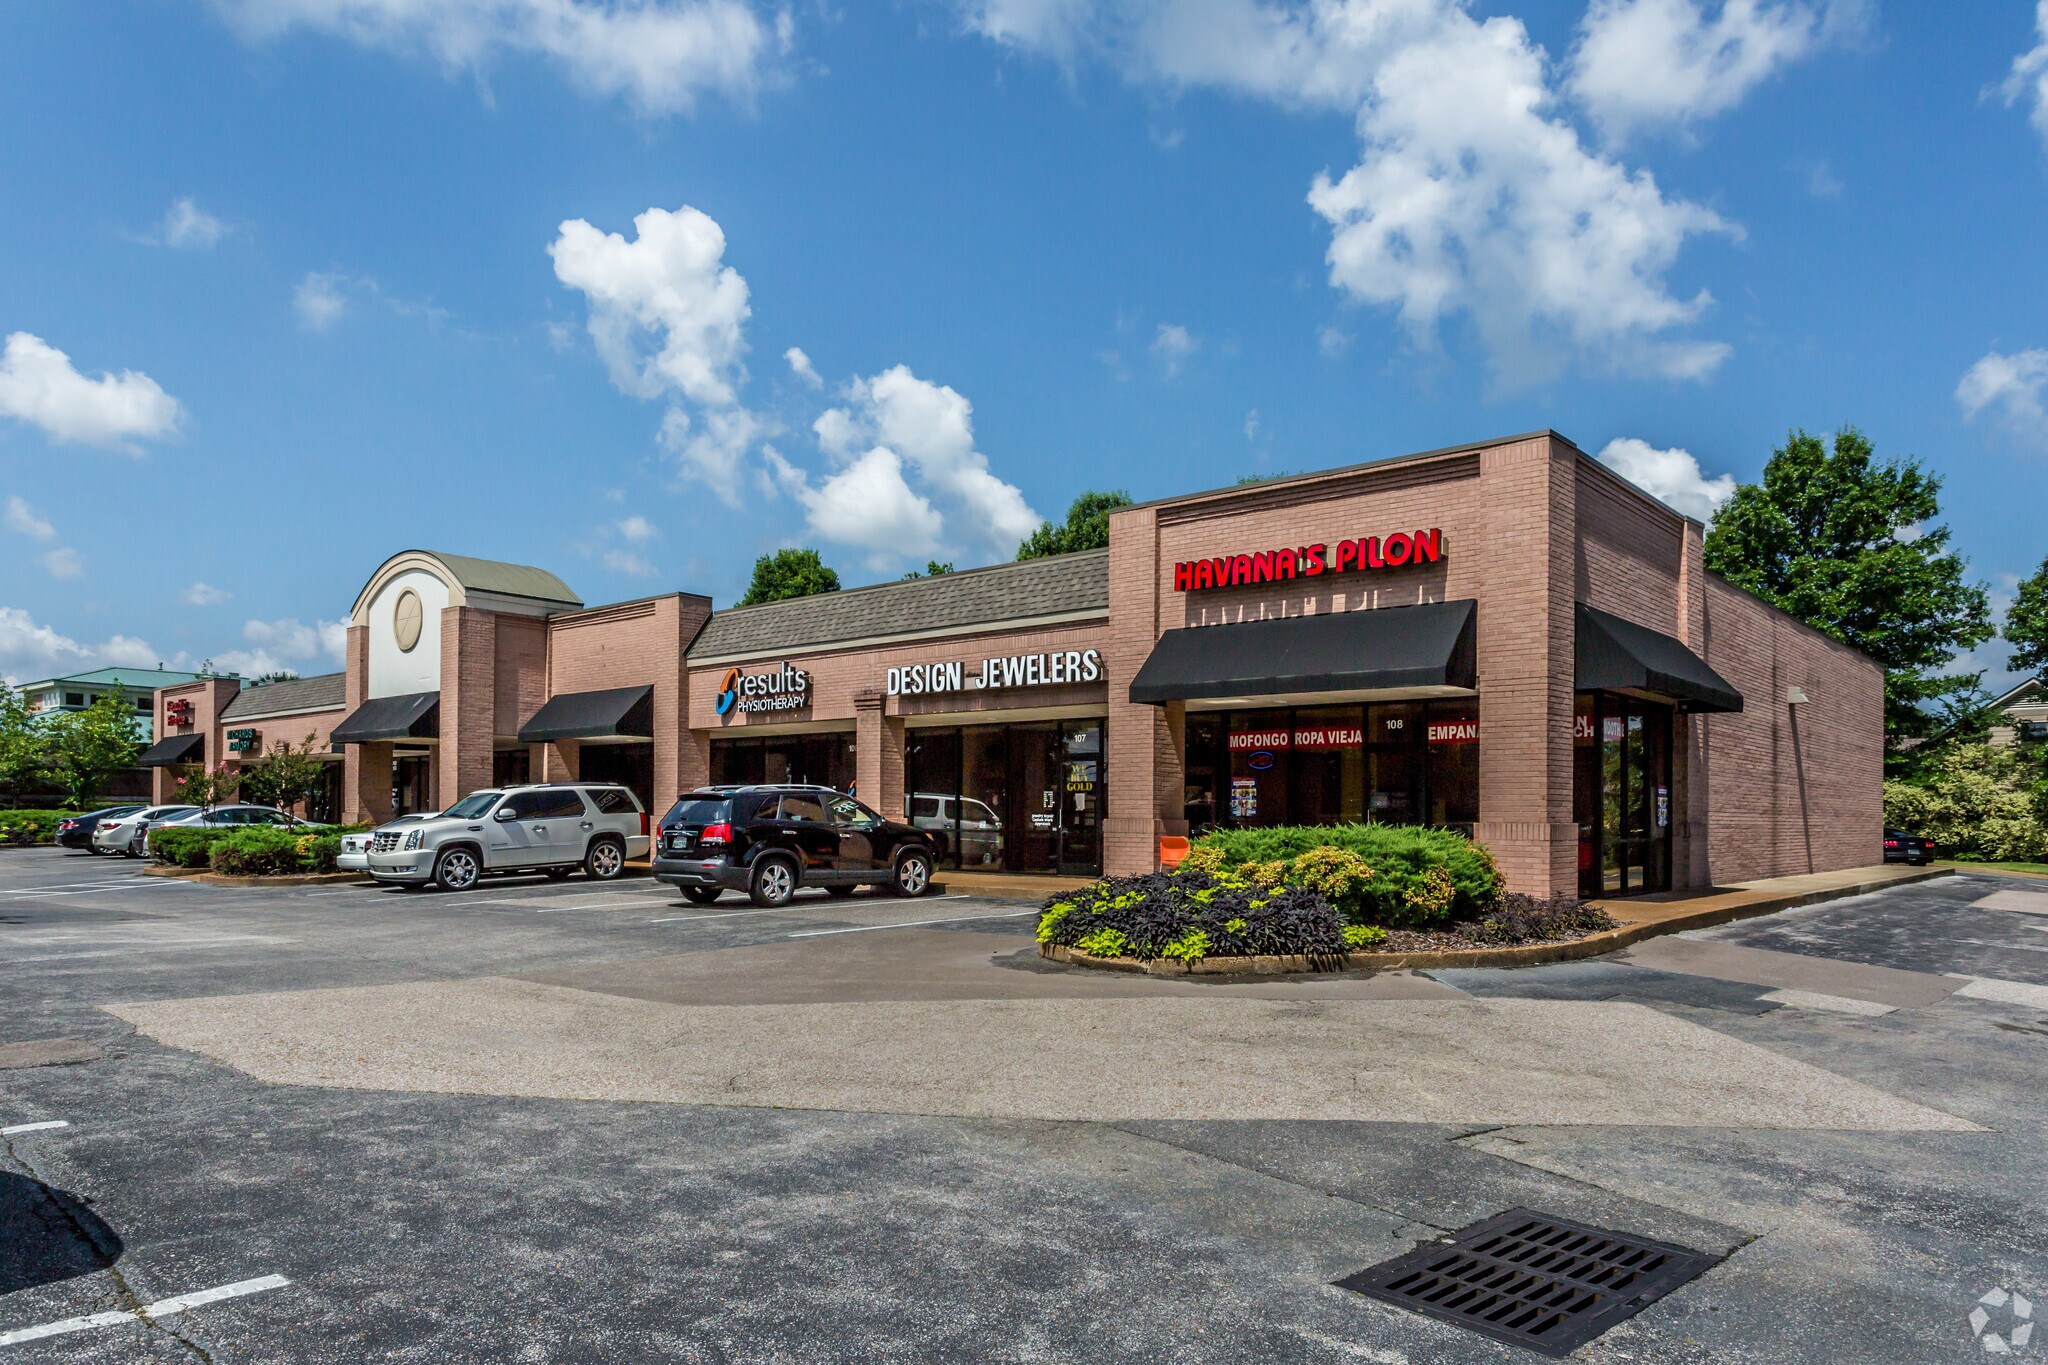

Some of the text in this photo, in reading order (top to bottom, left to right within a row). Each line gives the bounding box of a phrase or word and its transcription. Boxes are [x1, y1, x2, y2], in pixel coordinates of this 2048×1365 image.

[1174, 528, 1440, 591] HAVANA'S PILON
[737, 661, 806, 696] results
[887, 648, 1099, 696] DESIGN JEWELERS
[737, 696, 805, 712] PHYSIOTHERAPY
[1386, 719, 1403, 730] 108
[1074, 734, 1087, 743] 107
[1229, 732, 1289, 748] MOFONGO
[1295, 730, 1363, 745] ROPA VIEJA
[1428, 725, 1480, 740] EMPAN
[1071, 764, 1087, 773] WE
[1070, 773, 1088, 782] BUY
[1066, 782, 1093, 791] GOLD
